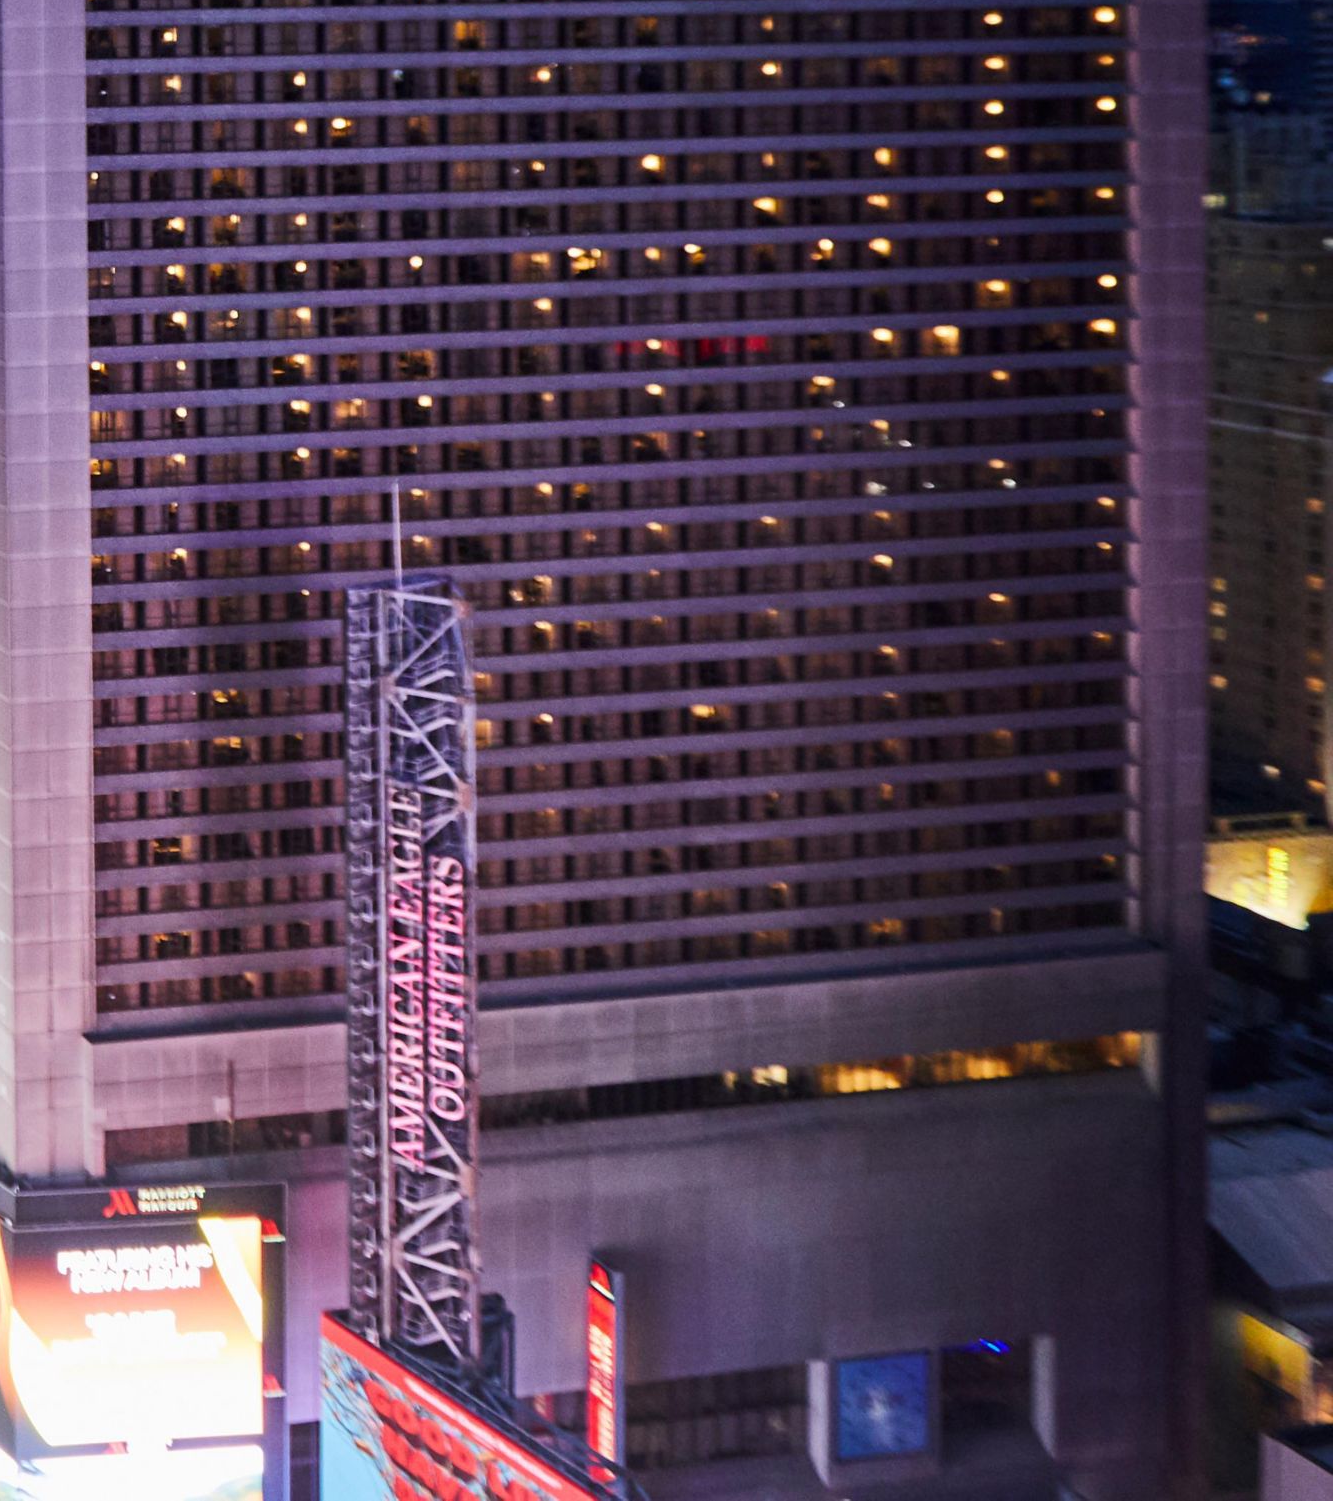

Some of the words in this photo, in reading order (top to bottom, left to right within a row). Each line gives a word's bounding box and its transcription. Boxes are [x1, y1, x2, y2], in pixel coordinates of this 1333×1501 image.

[388, 784, 423, 923] EAGLE
[389, 931, 424, 1168] AMERICAN
[427, 855, 465, 1121] OUTFITTERS
[137, 1186, 206, 1203] MARRIOTT
[137, 1198, 199, 1213] MARQUIS
